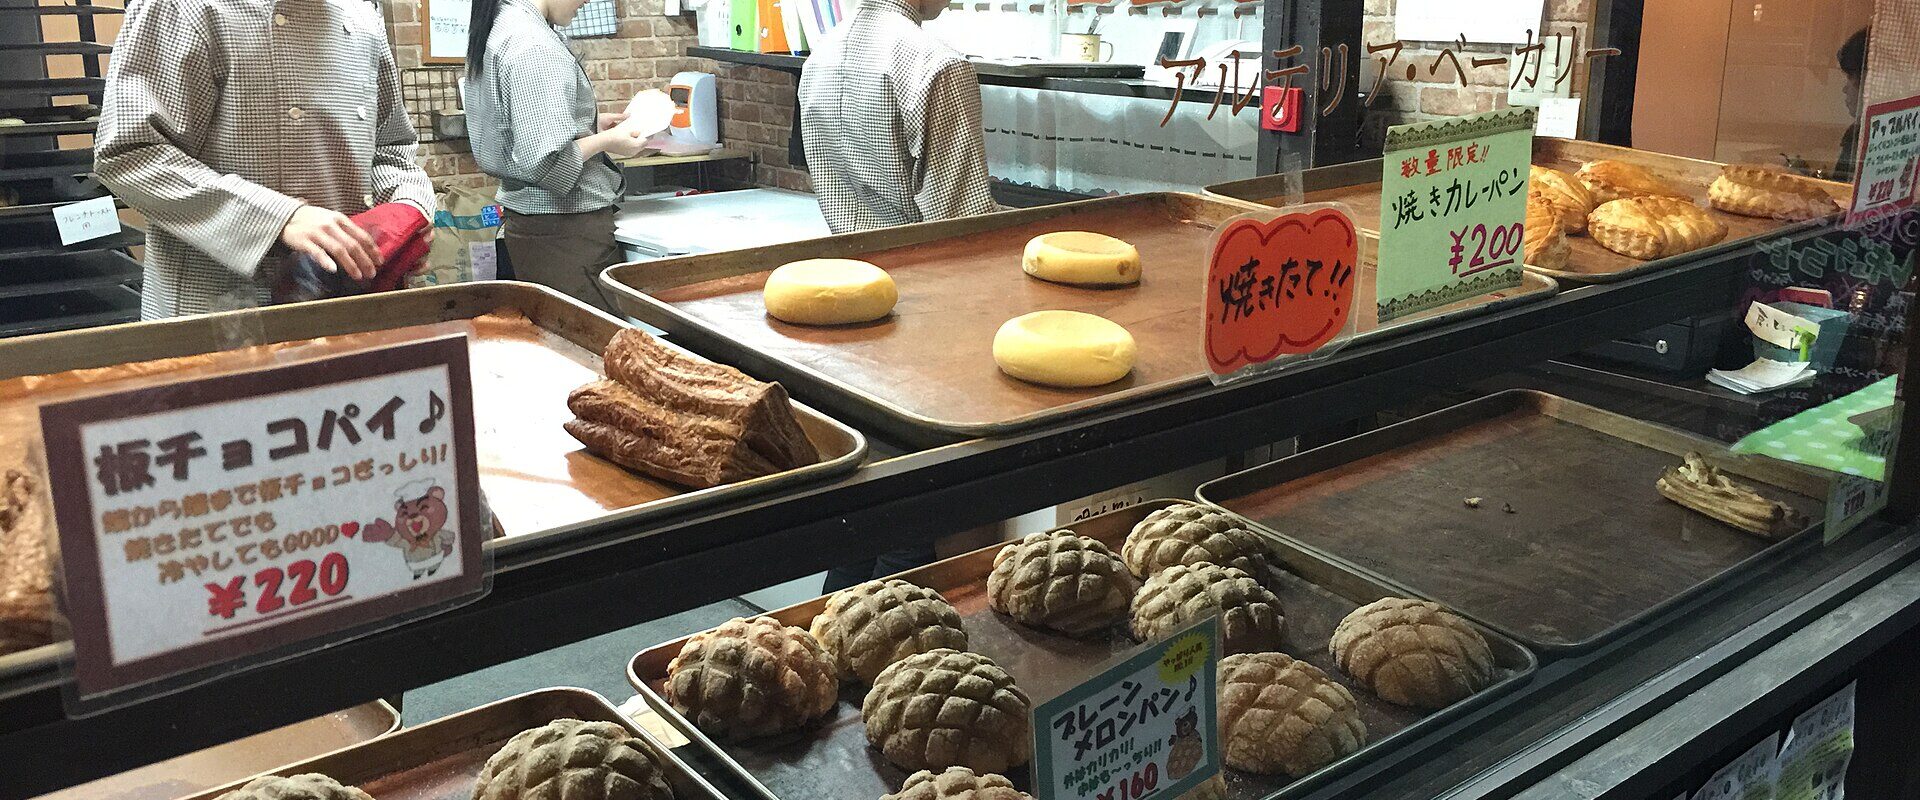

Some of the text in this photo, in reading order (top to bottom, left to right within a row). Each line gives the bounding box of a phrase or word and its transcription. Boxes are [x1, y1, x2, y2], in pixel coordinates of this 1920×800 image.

[1161, 26, 1622, 128] アルテリア・ベーカリー
[1391, 167, 1525, 230] 焼きカレーパン
[1448, 222, 1524, 275] ¥200
[95, 395, 406, 496] 板チョコパイ
[204, 552, 350, 620] ¥220
[1053, 681, 1142, 740] プレーン
[1074, 688, 1180, 761] メロンパン
